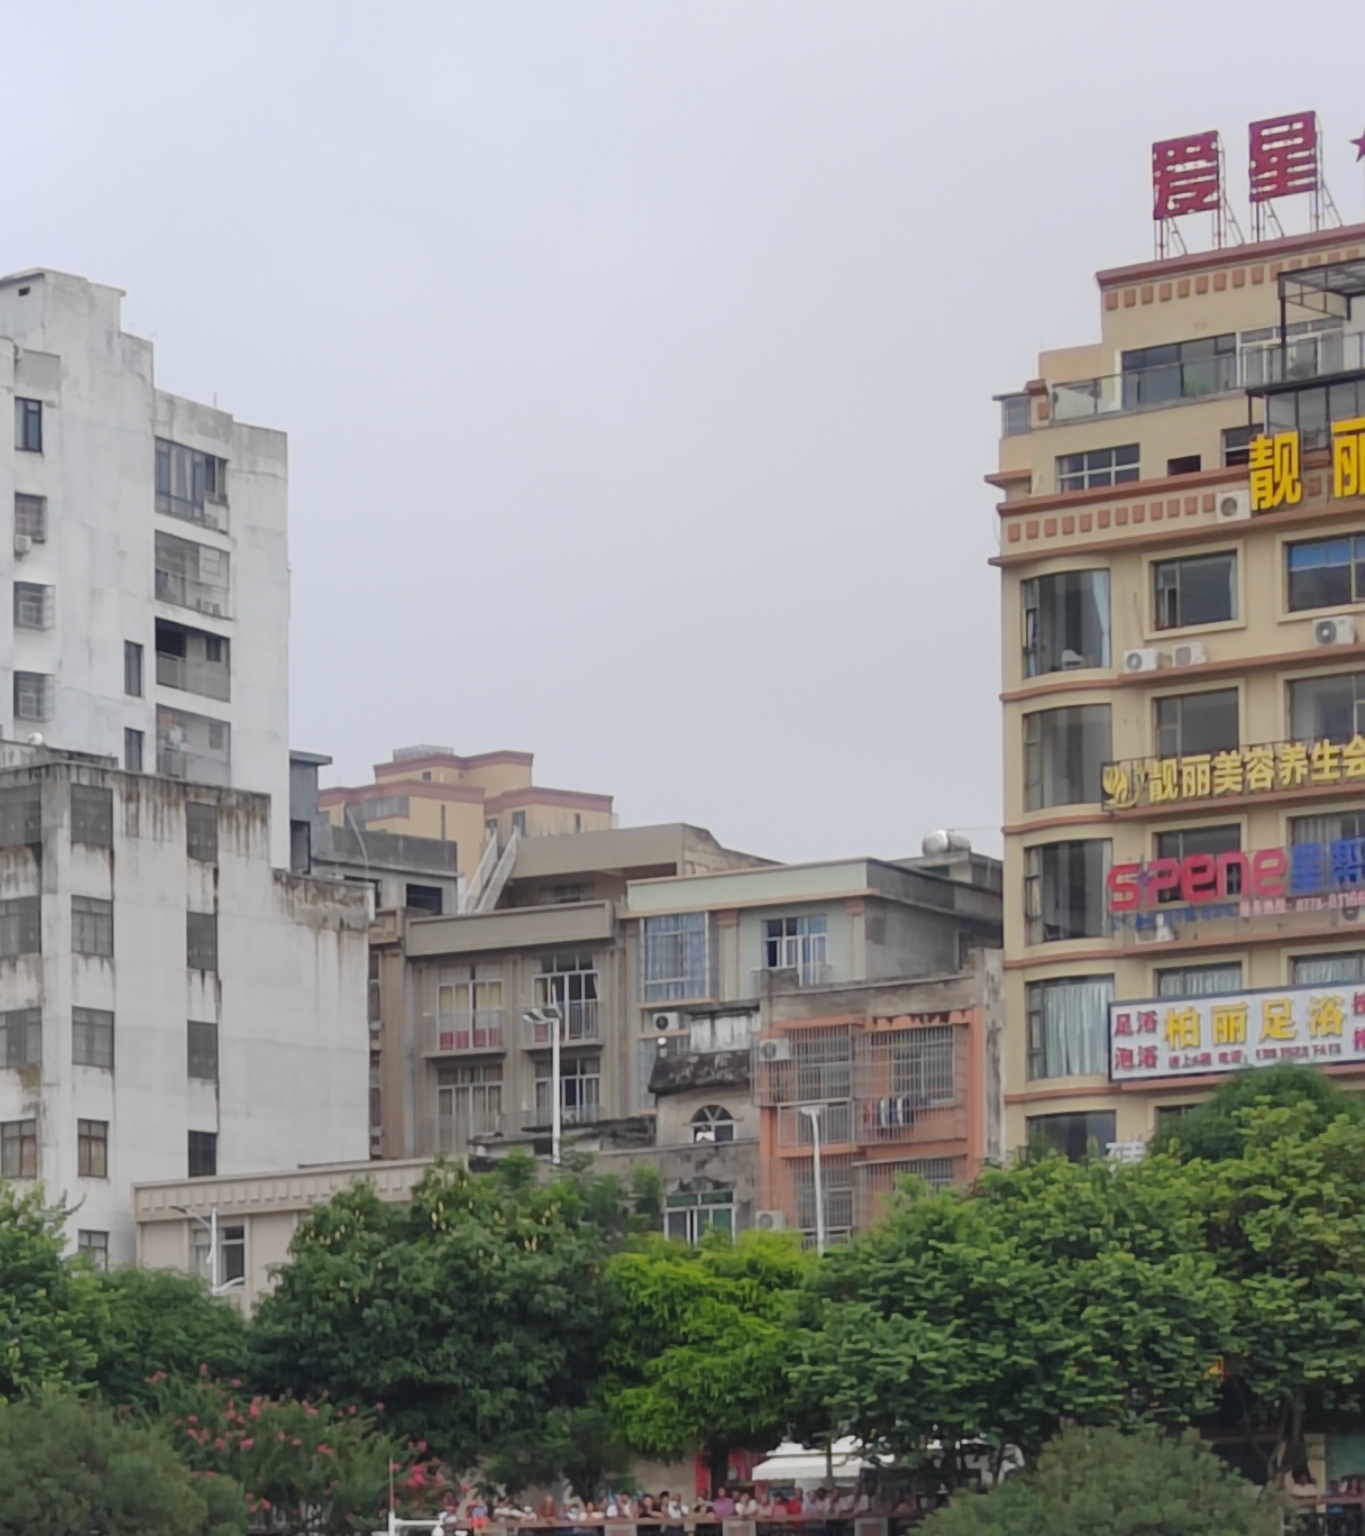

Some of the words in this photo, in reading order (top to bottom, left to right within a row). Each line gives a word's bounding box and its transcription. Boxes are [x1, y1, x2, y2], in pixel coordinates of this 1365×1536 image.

[1114, 1010, 1158, 1037] 足浴
[1164, 995, 1346, 1050] 柏丽足浴
